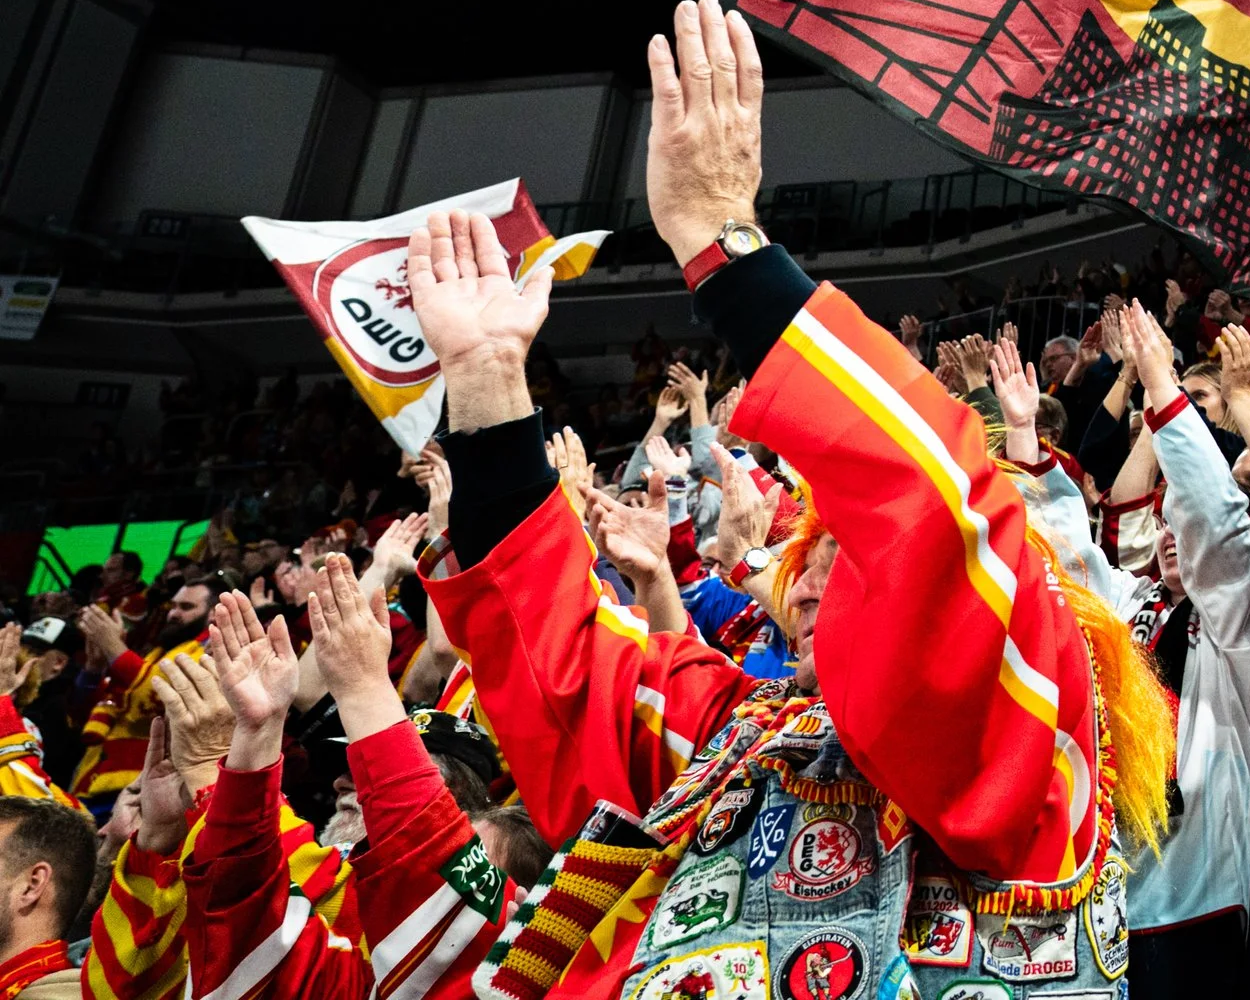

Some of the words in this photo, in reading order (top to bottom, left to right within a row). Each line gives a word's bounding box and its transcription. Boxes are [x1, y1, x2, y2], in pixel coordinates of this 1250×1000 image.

[340, 297, 426, 363] DEG
[800, 833, 816, 873] DEG
[793, 875, 852, 897] Eishockey
[801, 933, 853, 950] EISPIRATEN
[991, 936, 1015, 949] Rum
[733, 963, 746, 974] 10
[1023, 959, 1074, 976] DROGE
